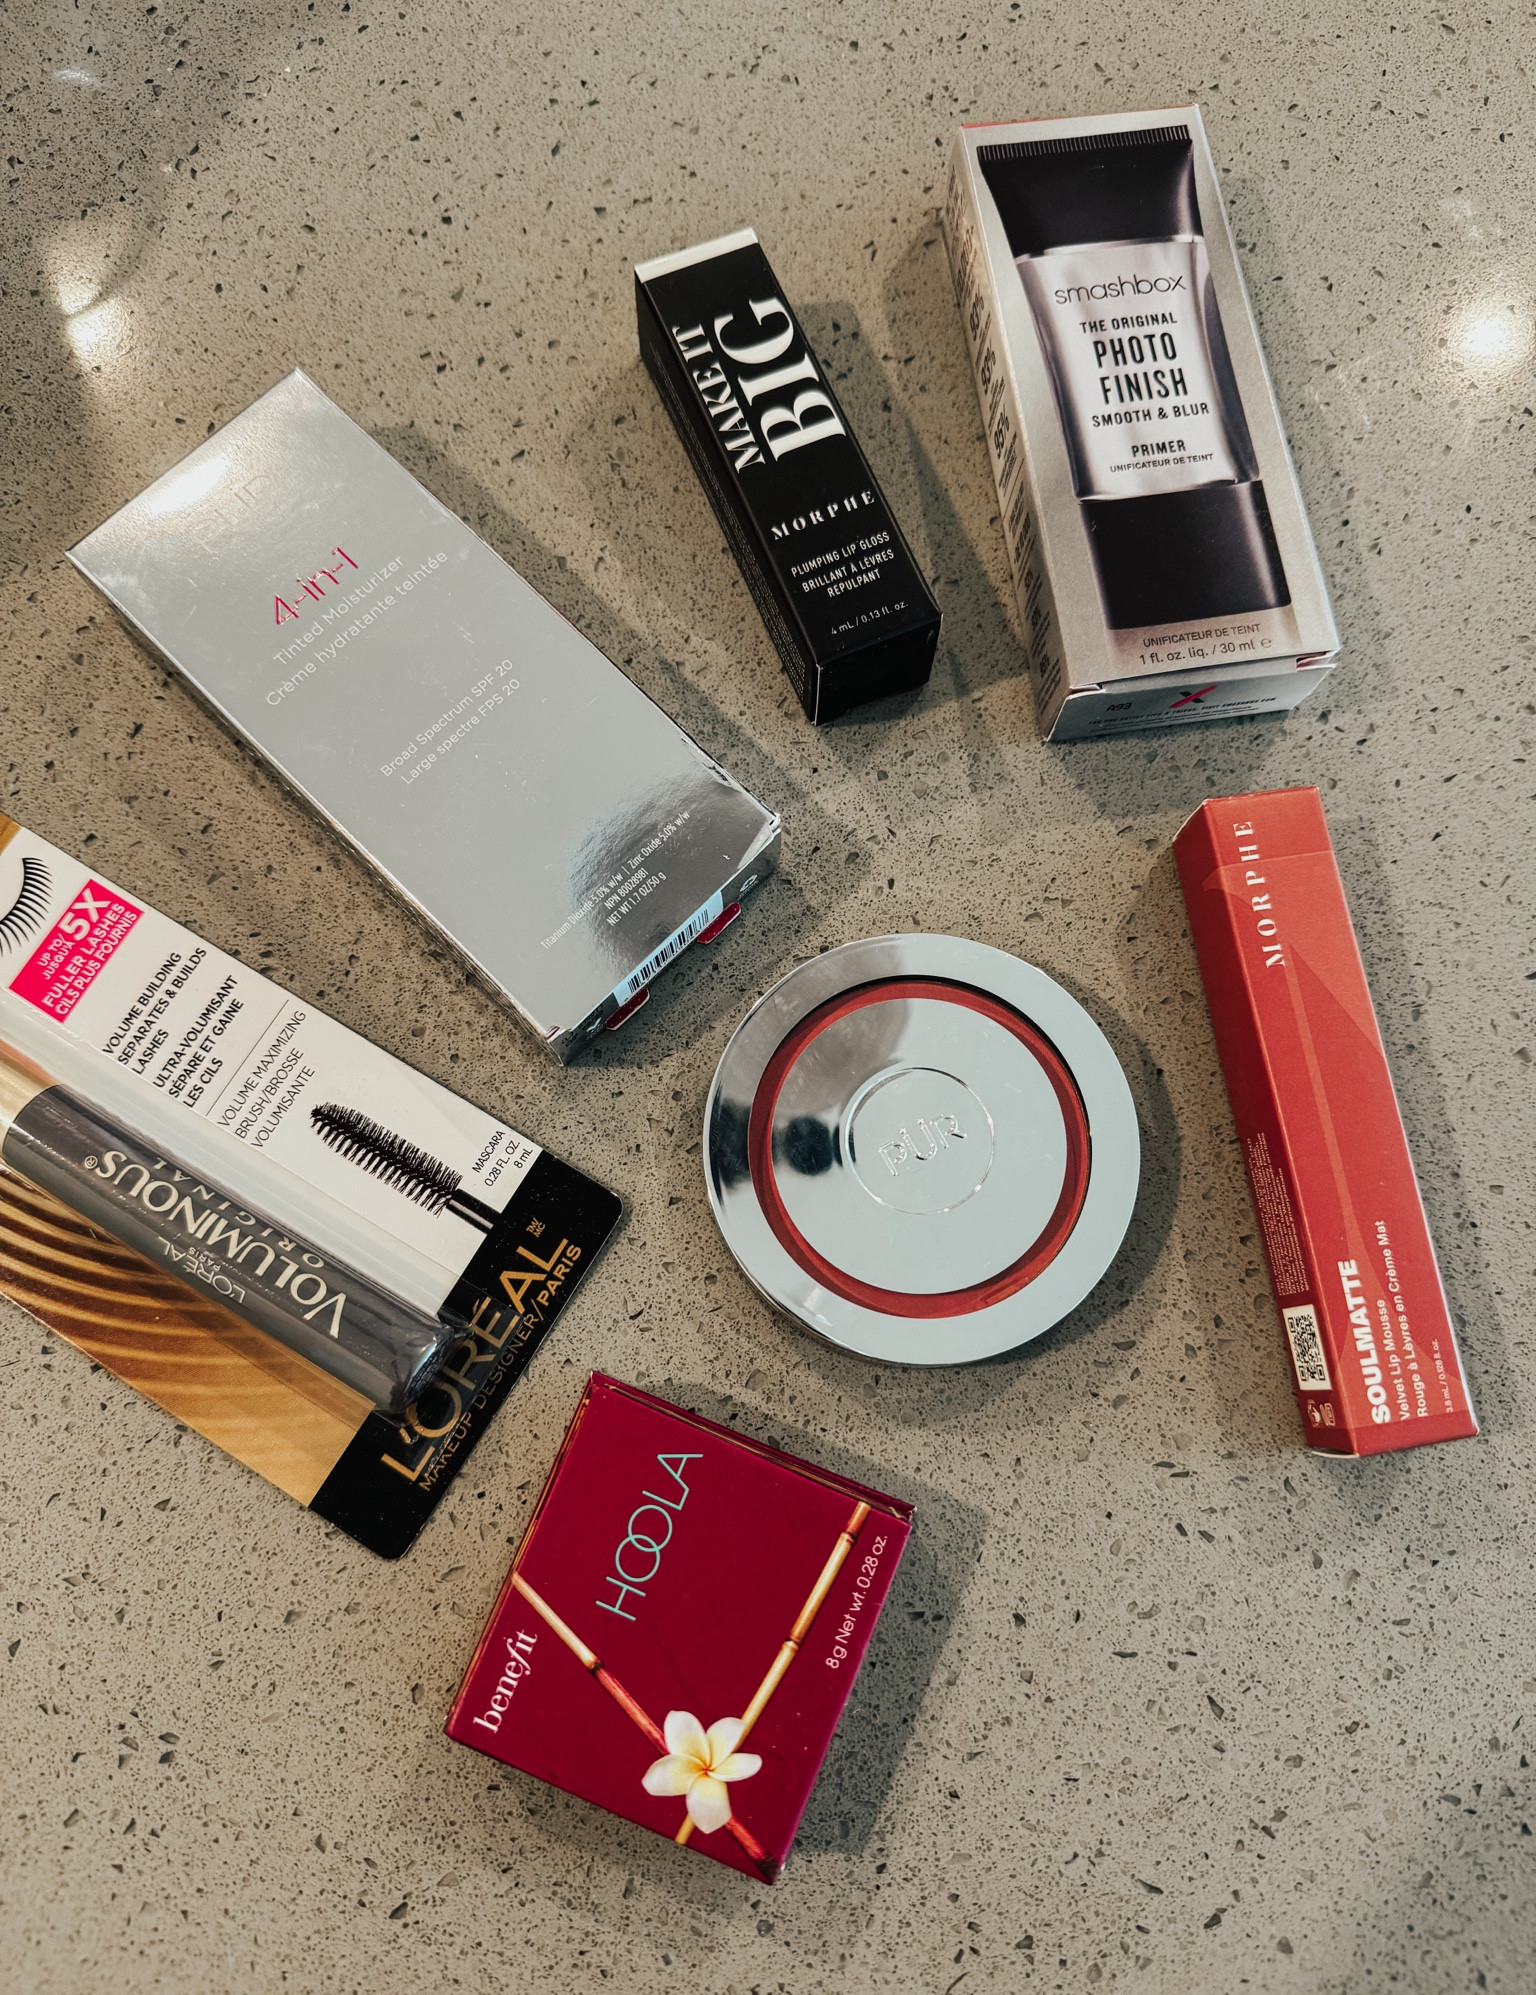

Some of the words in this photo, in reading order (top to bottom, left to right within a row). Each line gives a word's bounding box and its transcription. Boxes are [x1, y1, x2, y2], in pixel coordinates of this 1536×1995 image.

[1055, 274, 1186, 304] smashbox
[672, 323, 713, 363] IT
[1080, 320, 1107, 334] THE
[1112, 312, 1177, 330] ORIGINAL
[1093, 332, 1177, 369] PHOTO
[714, 297, 847, 462] BIG
[1100, 367, 1188, 405] FINISH
[692, 362, 766, 474] MAKE
[1092, 409, 1152, 427] SMOOTH
[1157, 408, 1169, 420] &
[1173, 403, 1210, 418] BLUR
[1110, 458, 1171, 473] UNIFICATEUR
[1172, 456, 1185, 465] DE
[1187, 453, 1214, 463] TEINT
[1131, 439, 1187, 458] PRIMER
[770, 490, 875, 540] MORPHE
[791, 550, 840, 578] PLUMPING
[841, 543, 857, 558] LIP
[859, 531, 890, 550] GLOSS
[802, 566, 848, 592] BRILLANT
[850, 562, 858, 574] À
[859, 549, 894, 571] LÈVRES
[275, 547, 358, 625] 4-in-1
[827, 568, 881, 598] REPULPANT
[267, 660, 317, 706] Crème
[315, 595, 396, 665] hydratante
[395, 551, 448, 596] teintée
[273, 622, 324, 665] Tinted
[322, 555, 404, 627] Moisturizer
[831, 627, 837, 635] 4
[839, 621, 854, 633] mL
[861, 609, 881, 623] 0.13
[881, 606, 893, 617] fl.
[894, 601, 909, 611] oz.
[1139, 654, 1147, 665] 1
[1150, 652, 1164, 664] fl.
[1166, 650, 1186, 661] oz.
[1188, 646, 1209, 659] liq.
[1212, 645, 1217, 655] /
[1220, 642, 1236, 654] 30
[1239, 640, 1255, 651] ml
[1143, 629, 1212, 648] UNIFICATEUR
[1215, 628, 1230, 640] DE
[1232, 624, 1261, 636] TEINT
[381, 742, 417, 776] Broad
[416, 696, 473, 744] Spectrum
[471, 673, 494, 697] SPF
[495, 660, 513, 677] 20
[1106, 702, 1132, 712] A93
[401, 753, 437, 784] Large
[437, 715, 480, 754] spectre
[478, 693, 503, 717] FPS
[502, 679, 520, 696] 20
[541, 921, 571, 949] Titanium
[568, 900, 595, 924] Dioxide
[592, 884, 610, 902] 5.0%
[607, 872, 624, 889] w/w
[627, 852, 645, 870] Zinc
[640, 837, 662, 857] Oxide
[659, 823, 677, 842] 5.0%
[674, 811, 691, 827] w/w
[604, 893, 621, 910] NPN
[617, 867, 650, 898] 80028981
[606, 911, 622, 927] NET
[618, 901, 632, 915] WT
[628, 891, 642, 906] 1.7
[638, 876, 660, 897] OZ/50
[657, 871, 667, 881] g
[1233, 821, 1286, 968] MORPHE
[38, 952, 51, 967] UP
[57, 888, 112, 941] 5X
[42, 955, 87, 1007] FULLER
[80, 903, 125, 955] LASHES
[55, 987, 80, 1015] CILS
[74, 959, 101, 990] PLUS
[95, 911, 138, 961] FOURNIS
[102, 1005, 144, 1055] VOLUME
[137, 952, 182, 1007] BUILDING
[117, 997, 170, 1066] SEPARATES
[165, 989, 177, 999] &
[172, 947, 207, 990] BUILDS
[132, 1029, 169, 1075] LASHES
[152, 974, 238, 1089] ULTRA-VOLUMISANT
[168, 1051, 206, 1099] SÉPARE
[200, 1035, 216, 1053] ET
[212, 998, 244, 1036] GAINE
[183, 1086, 205, 1108] LES
[200, 1057, 223, 1086] CILS
[217, 1077, 258, 1127] VOLUME
[253, 1010, 307, 1080] MAXIMIZING
[234, 1047, 304, 1139] BRUSH/BROSSE
[251, 1065, 316, 1149] VOLUMISANTE
[472, 1130, 506, 1173] MASCARA
[484, 1167, 501, 1187] 0.28
[496, 1157, 511, 1170] FL.
[505, 1140, 521, 1155] OZ.
[514, 1160, 523, 1168] 8
[521, 1148, 533, 1163] mL
[153, 1156, 325, 1269] ORIGINAL
[1374, 1220, 1391, 1246] Mat
[158, 1236, 247, 1304] L'ORÉAL
[188, 1246, 221, 1272] PARIS
[1384, 1248, 1400, 1293] Crème
[1377, 1299, 1397, 1351] Mousse
[1395, 1295, 1405, 1311] en
[381, 1238, 568, 1482] L'ORÉAL
[1338, 1259, 1391, 1425] SOULMATTE
[1398, 1314, 1417, 1360] Lèvres
[1388, 1354, 1402, 1376] Lip
[1407, 1360, 1418, 1371] à
[1393, 1378, 1411, 1421] Velvet
[1411, 1374, 1429, 1418] Rouge
[418, 1412, 473, 1492] MAKEUP
[595, 1453, 704, 1621] HOOLA
[872, 1535, 888, 1555] oz.
[857, 1555, 878, 1588] 0.28
[850, 1591, 867, 1612] wt.
[835, 1613, 856, 1644] Net
[473, 1629, 538, 1733] benefit
